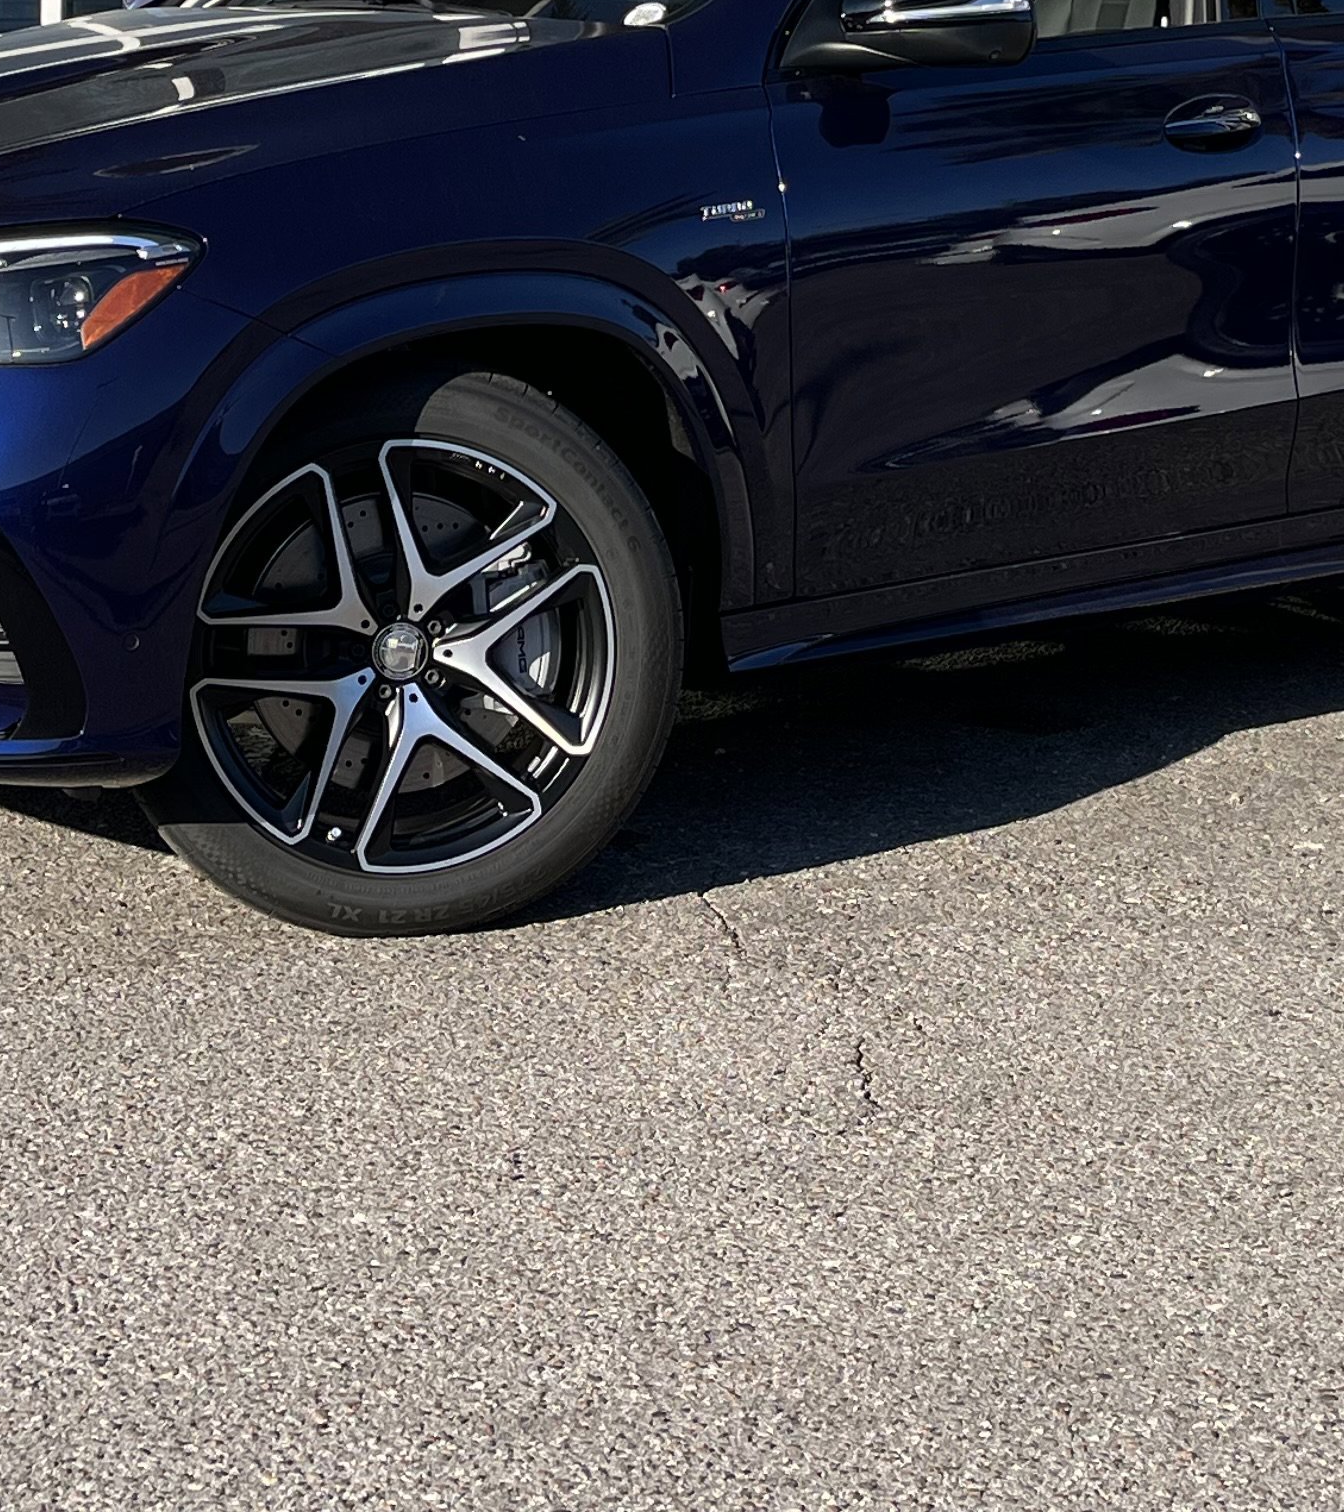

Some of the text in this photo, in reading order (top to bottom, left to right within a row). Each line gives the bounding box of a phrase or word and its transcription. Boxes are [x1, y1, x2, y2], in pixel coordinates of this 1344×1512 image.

[493, 405, 629, 530] SportContact
[516, 626, 528, 674] AMG
[326, 901, 363, 922] XL
